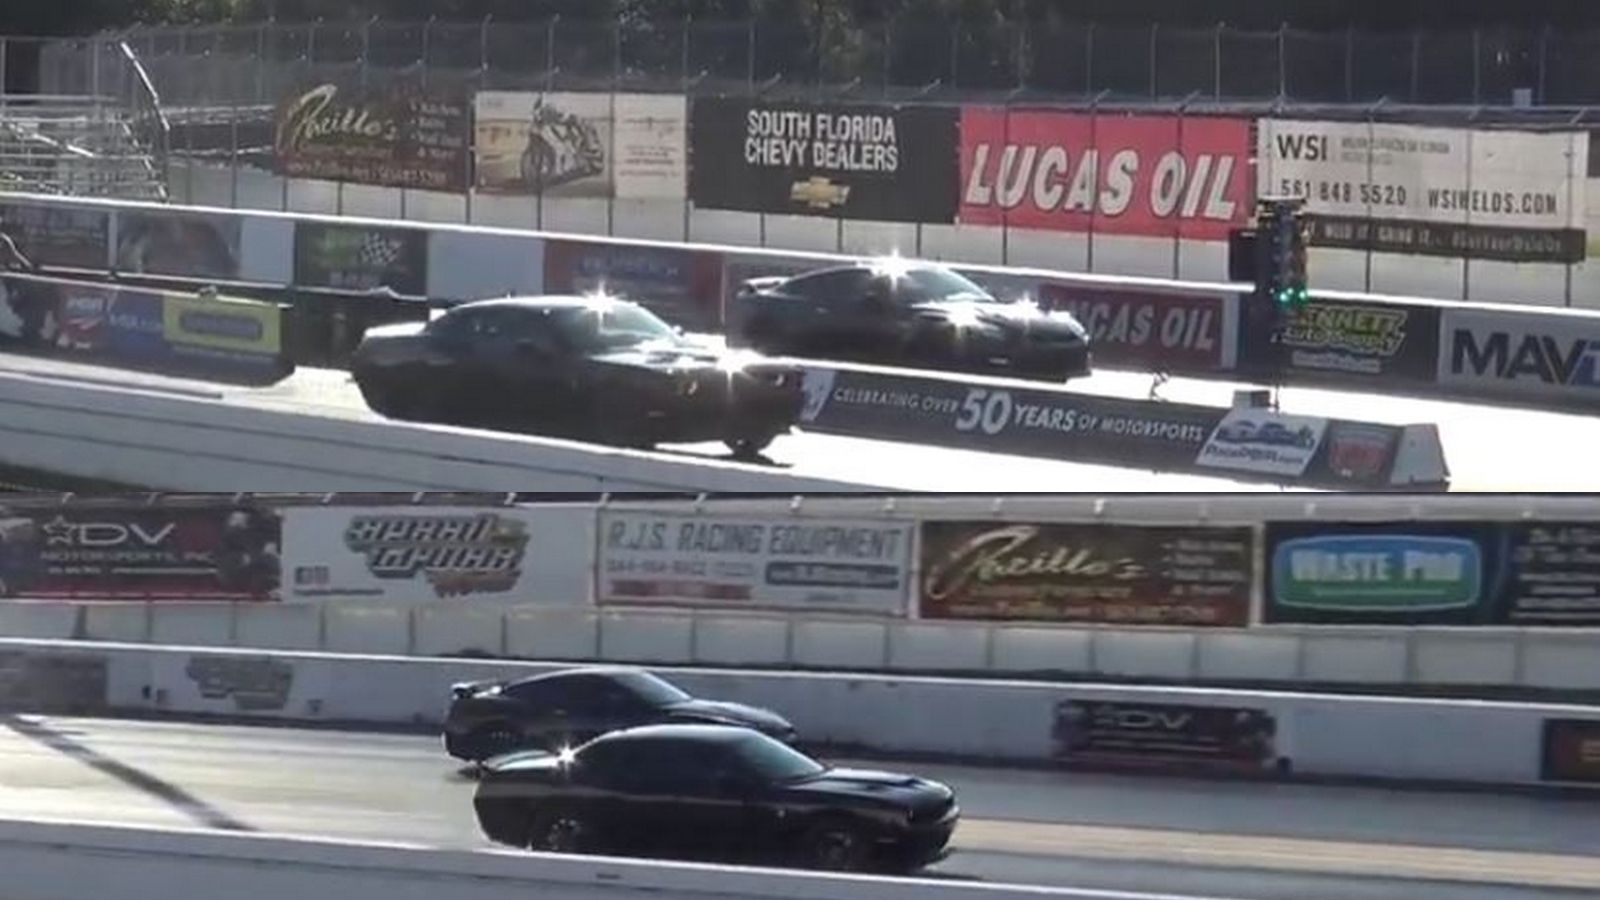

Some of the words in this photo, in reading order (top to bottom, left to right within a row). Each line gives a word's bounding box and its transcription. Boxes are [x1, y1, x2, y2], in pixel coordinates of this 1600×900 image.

[748, 110, 811, 138] SOUTH
[816, 113, 896, 143] FLORIDA
[745, 138, 808, 167] CHEVY
[813, 142, 898, 171] DEALERS
[1277, 133, 1328, 161] WSI
[964, 143, 1139, 216] LUCAS
[1150, 151, 1236, 220] OIL
[1360, 183, 1406, 206] 5520
[1428, 188, 1557, 215] WSIWELDS.COM
[1160, 307, 1215, 349] OIL
[833, 387, 919, 409] CELEBRATING
[921, 395, 958, 413] OVER
[956, 388, 1012, 435] 50
[1013, 404, 1076, 431] YEARS
[1101, 417, 1203, 441] MOTORSPORTS
[677, 522, 765, 554] RACING
